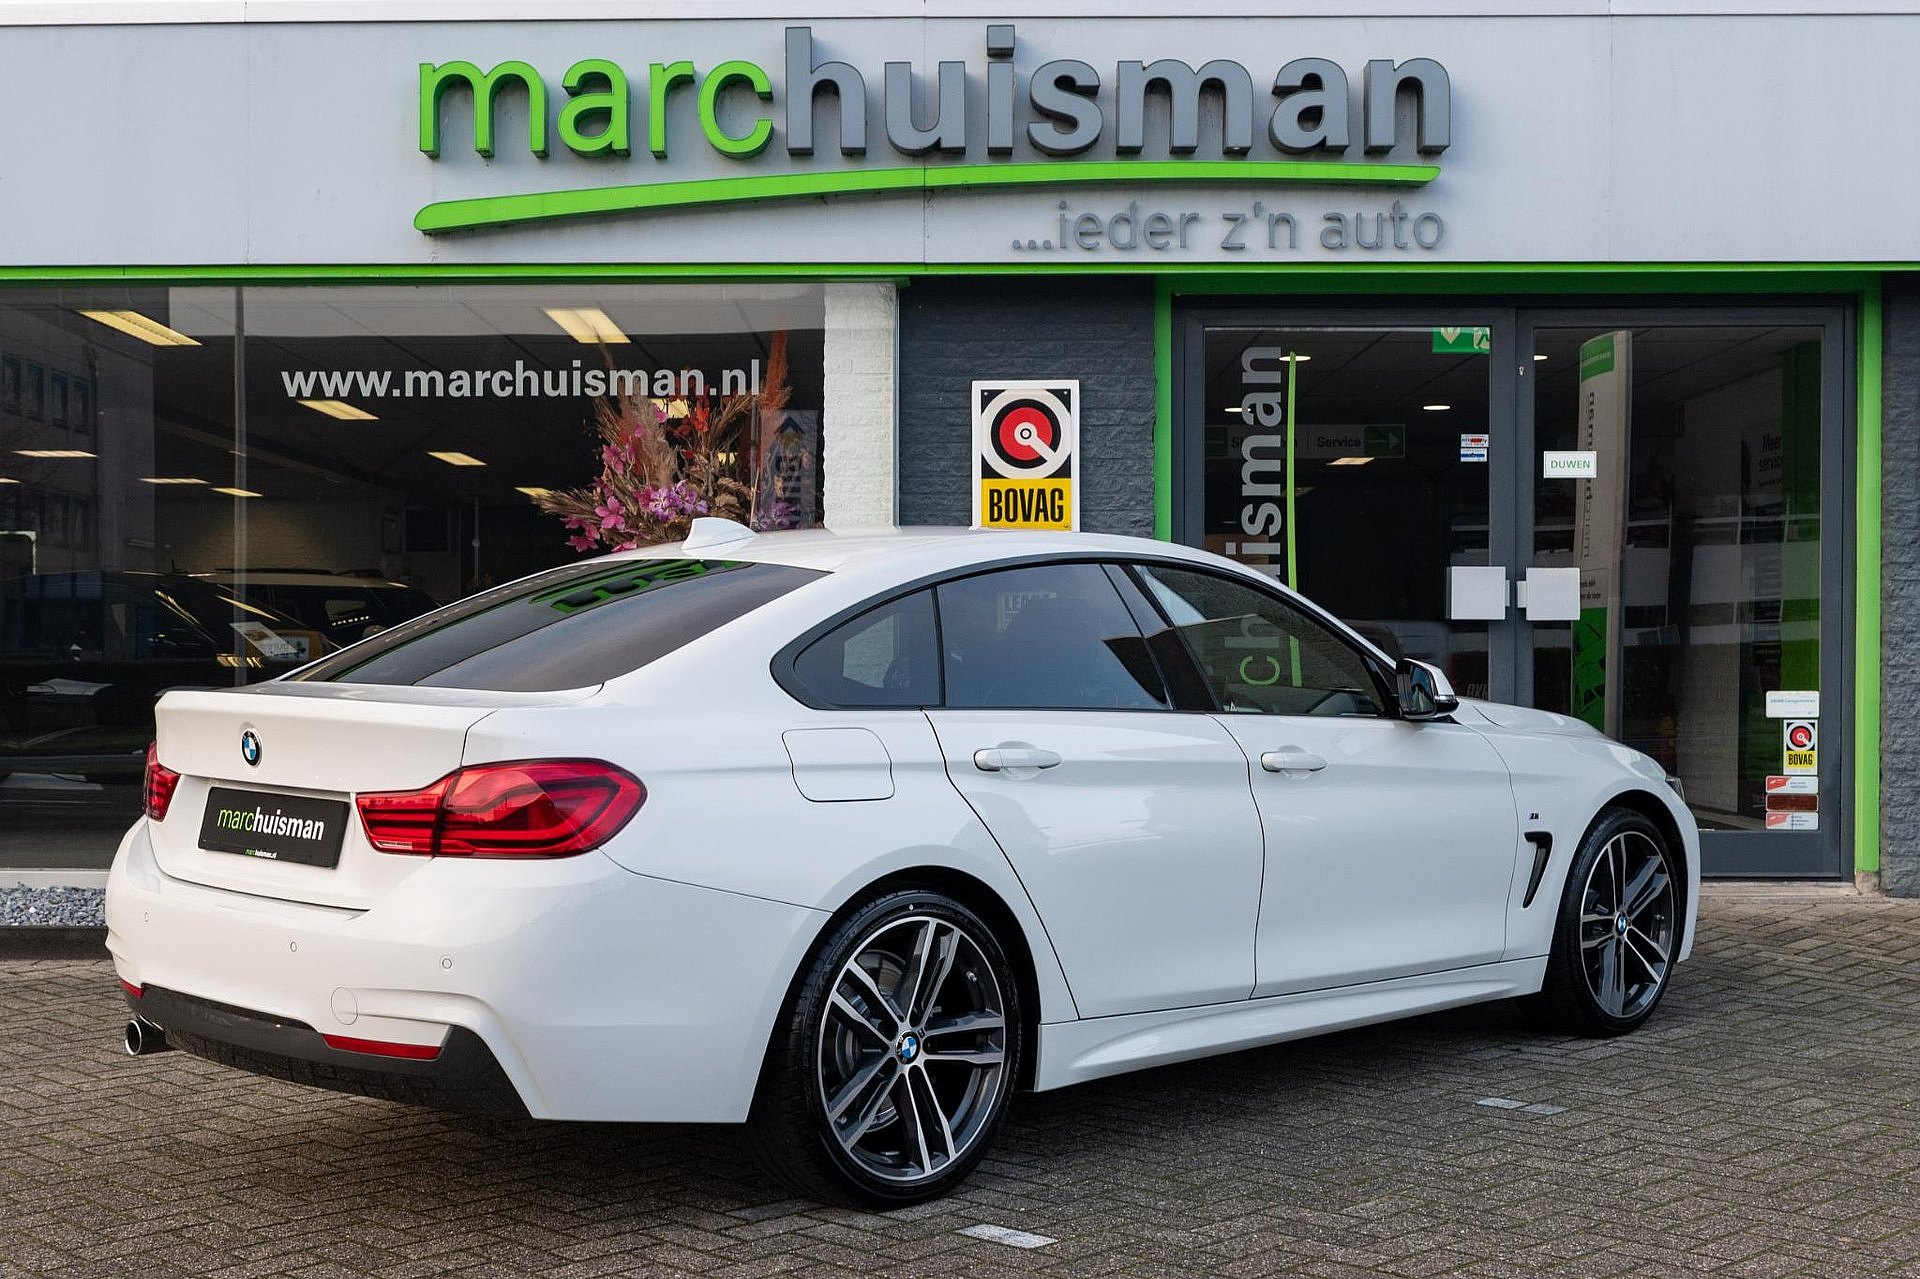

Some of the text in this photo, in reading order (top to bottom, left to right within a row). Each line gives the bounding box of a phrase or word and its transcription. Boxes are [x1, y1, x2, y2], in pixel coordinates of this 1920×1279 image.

[419, 25, 1451, 159] marchuisman
[1220, 201, 1297, 250] z'n
[1320, 201, 1444, 250] auto
[281, 359, 760, 398] www.marchuisman.nl
[1316, 436, 1362, 448] Service
[1551, 460, 1590, 469] DUWEN
[989, 488, 1064, 522] BOVAG
[1788, 754, 1813, 765] BOVAG
[217, 806, 324, 840] marchuisman
